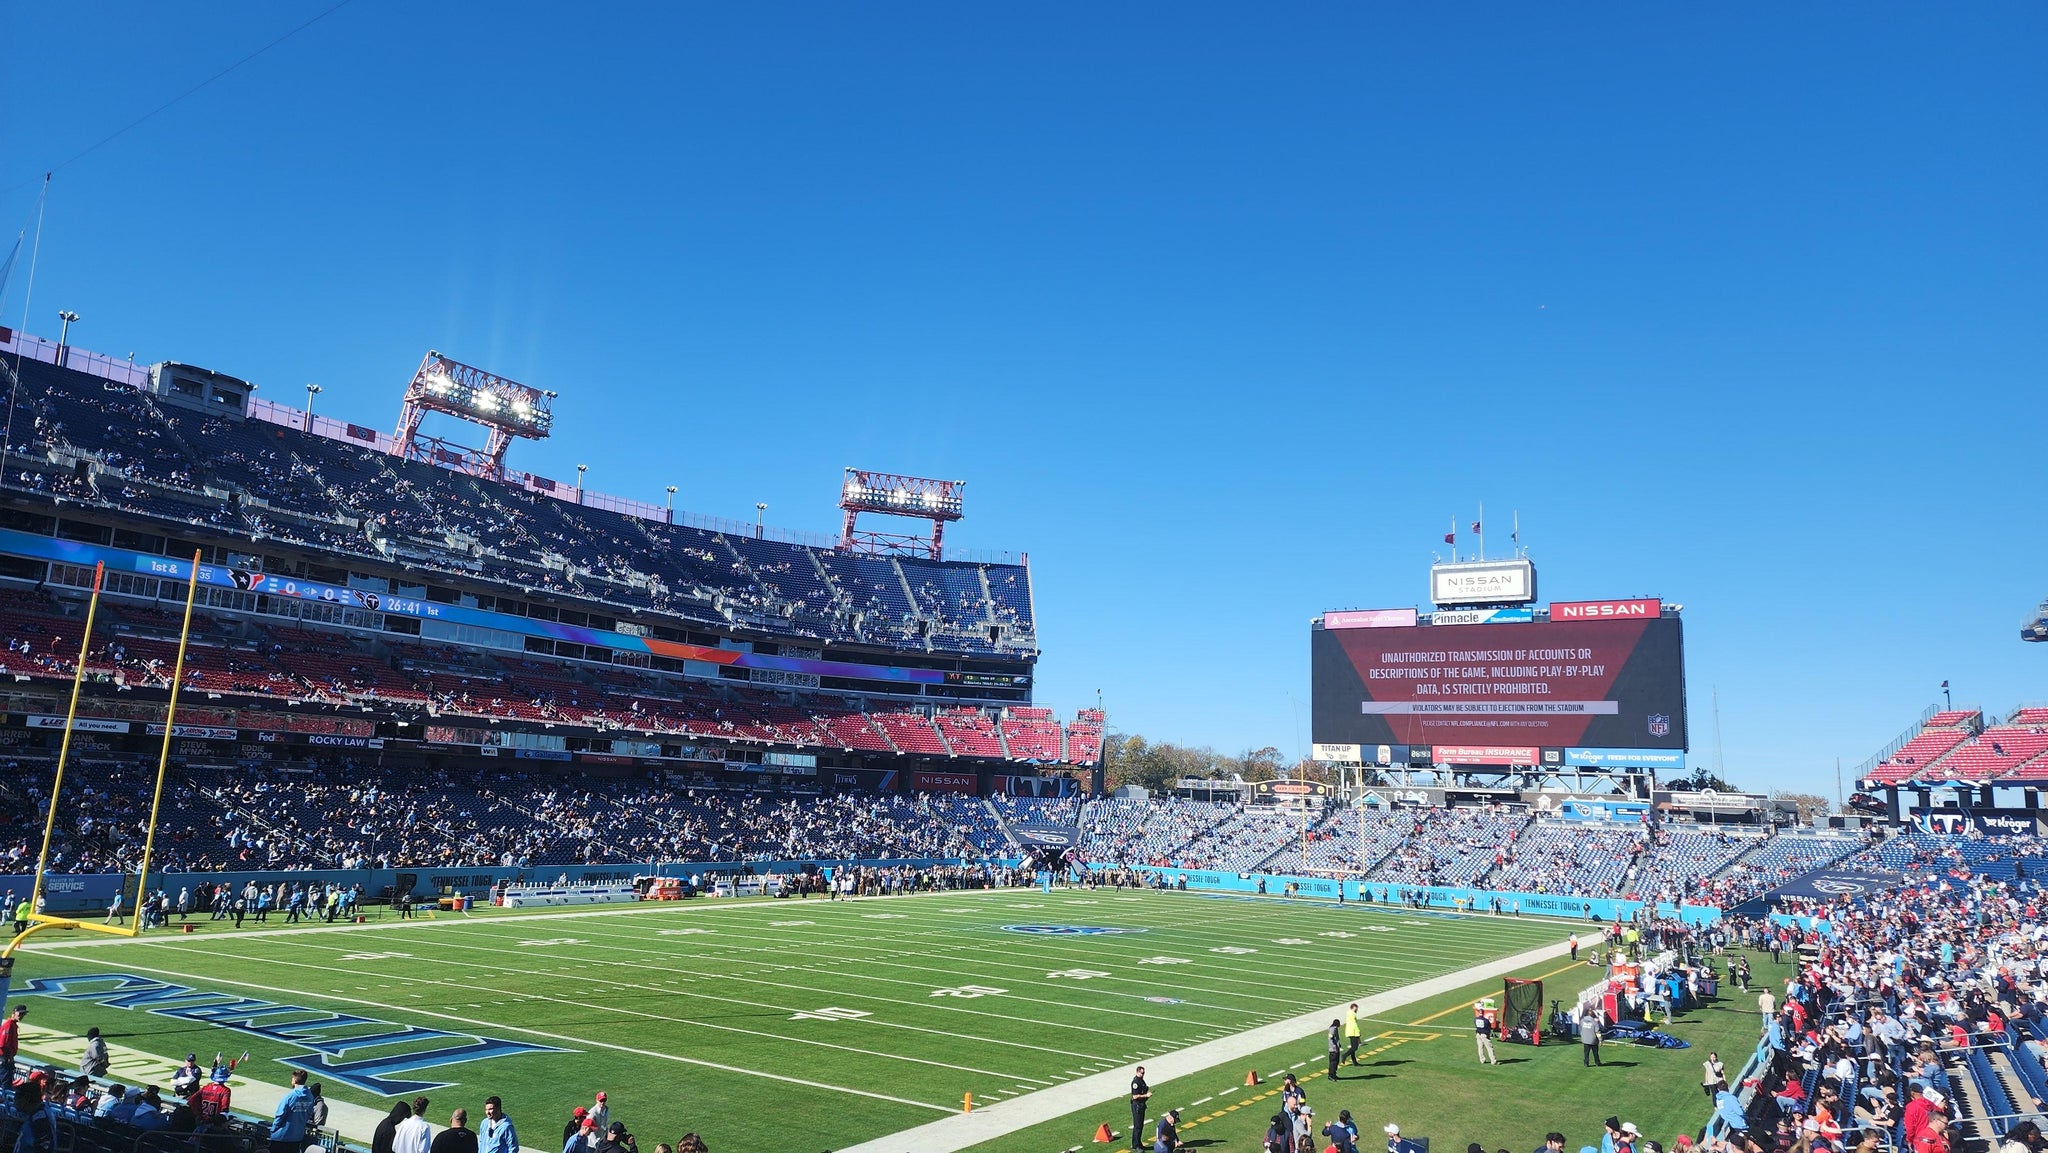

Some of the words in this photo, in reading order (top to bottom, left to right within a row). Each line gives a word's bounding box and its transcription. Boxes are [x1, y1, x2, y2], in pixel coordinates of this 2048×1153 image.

[151, 561, 167, 572] 1st
[169, 564, 178, 574] &
[199, 571, 211, 581] 35
[1448, 575, 1512, 586] NISSAN
[285, 582, 296, 594] 0
[1458, 585, 1502, 593] STADIUM
[324, 589, 335, 600] 0
[387, 598, 420, 614] 26:41
[426, 606, 439, 616] 1st
[1563, 603, 1645, 617] NISSAN
[1433, 612, 1479, 624] Pinnacle
[1381, 651, 1446, 663] UNAUTHORIZED
[1448, 650, 1513, 662] TRANSMISSION
[1515, 649, 1526, 661] OF
[1528, 649, 1576, 660] ACCOUNTS
[1578, 648, 1592, 660] OR
[1369, 667, 1428, 679] DESCRIPTIONS
[1430, 667, 1441, 678] OF
[1443, 667, 1459, 678] THE
[1461, 667, 1489, 679] GAME,
[1491, 666, 1538, 678] INCLUDING
[1540, 665, 1605, 677] PLAY-BY-PLAY
[1416, 684, 1441, 696] DATA,
[1442, 684, 1451, 695] IS
[1453, 683, 1492, 695] STRICTLY
[1493, 683, 1552, 694] PROHIBITED.
[1412, 704, 1442, 712] VIOLATORS
[1498, 704, 1525, 712] EJECTION
[1526, 704, 1544, 712] FROM
[1545, 704, 1556, 712] THE
[1557, 704, 1584, 712] STADIUM
[101, 722, 118, 730] need.
[1650, 723, 1667, 733] NFL
[258, 732, 286, 743] FedEx
[309, 735, 343, 746] ROCKY
[344, 737, 366, 747] LAW
[180, 740, 208, 749] STEVE
[241, 744, 265, 752] EDDIE
[1438, 748, 1457, 756] Farm
[1457, 748, 1484, 756] Bureau
[1484, 749, 1532, 757] INSURANCE
[1580, 750, 1604, 764] Kroger
[921, 776, 970, 786] NISSAN
[1997, 815, 2031, 833] Kroger
[48, 880, 85, 892] SERVICE
[1780, 894, 1817, 903] NISSAN
[1525, 898, 1558, 911] TENNESSEE
[1560, 902, 1581, 912] TOUGH
[928, 984, 1009, 998] 20
[786, 1006, 875, 1022] 10
